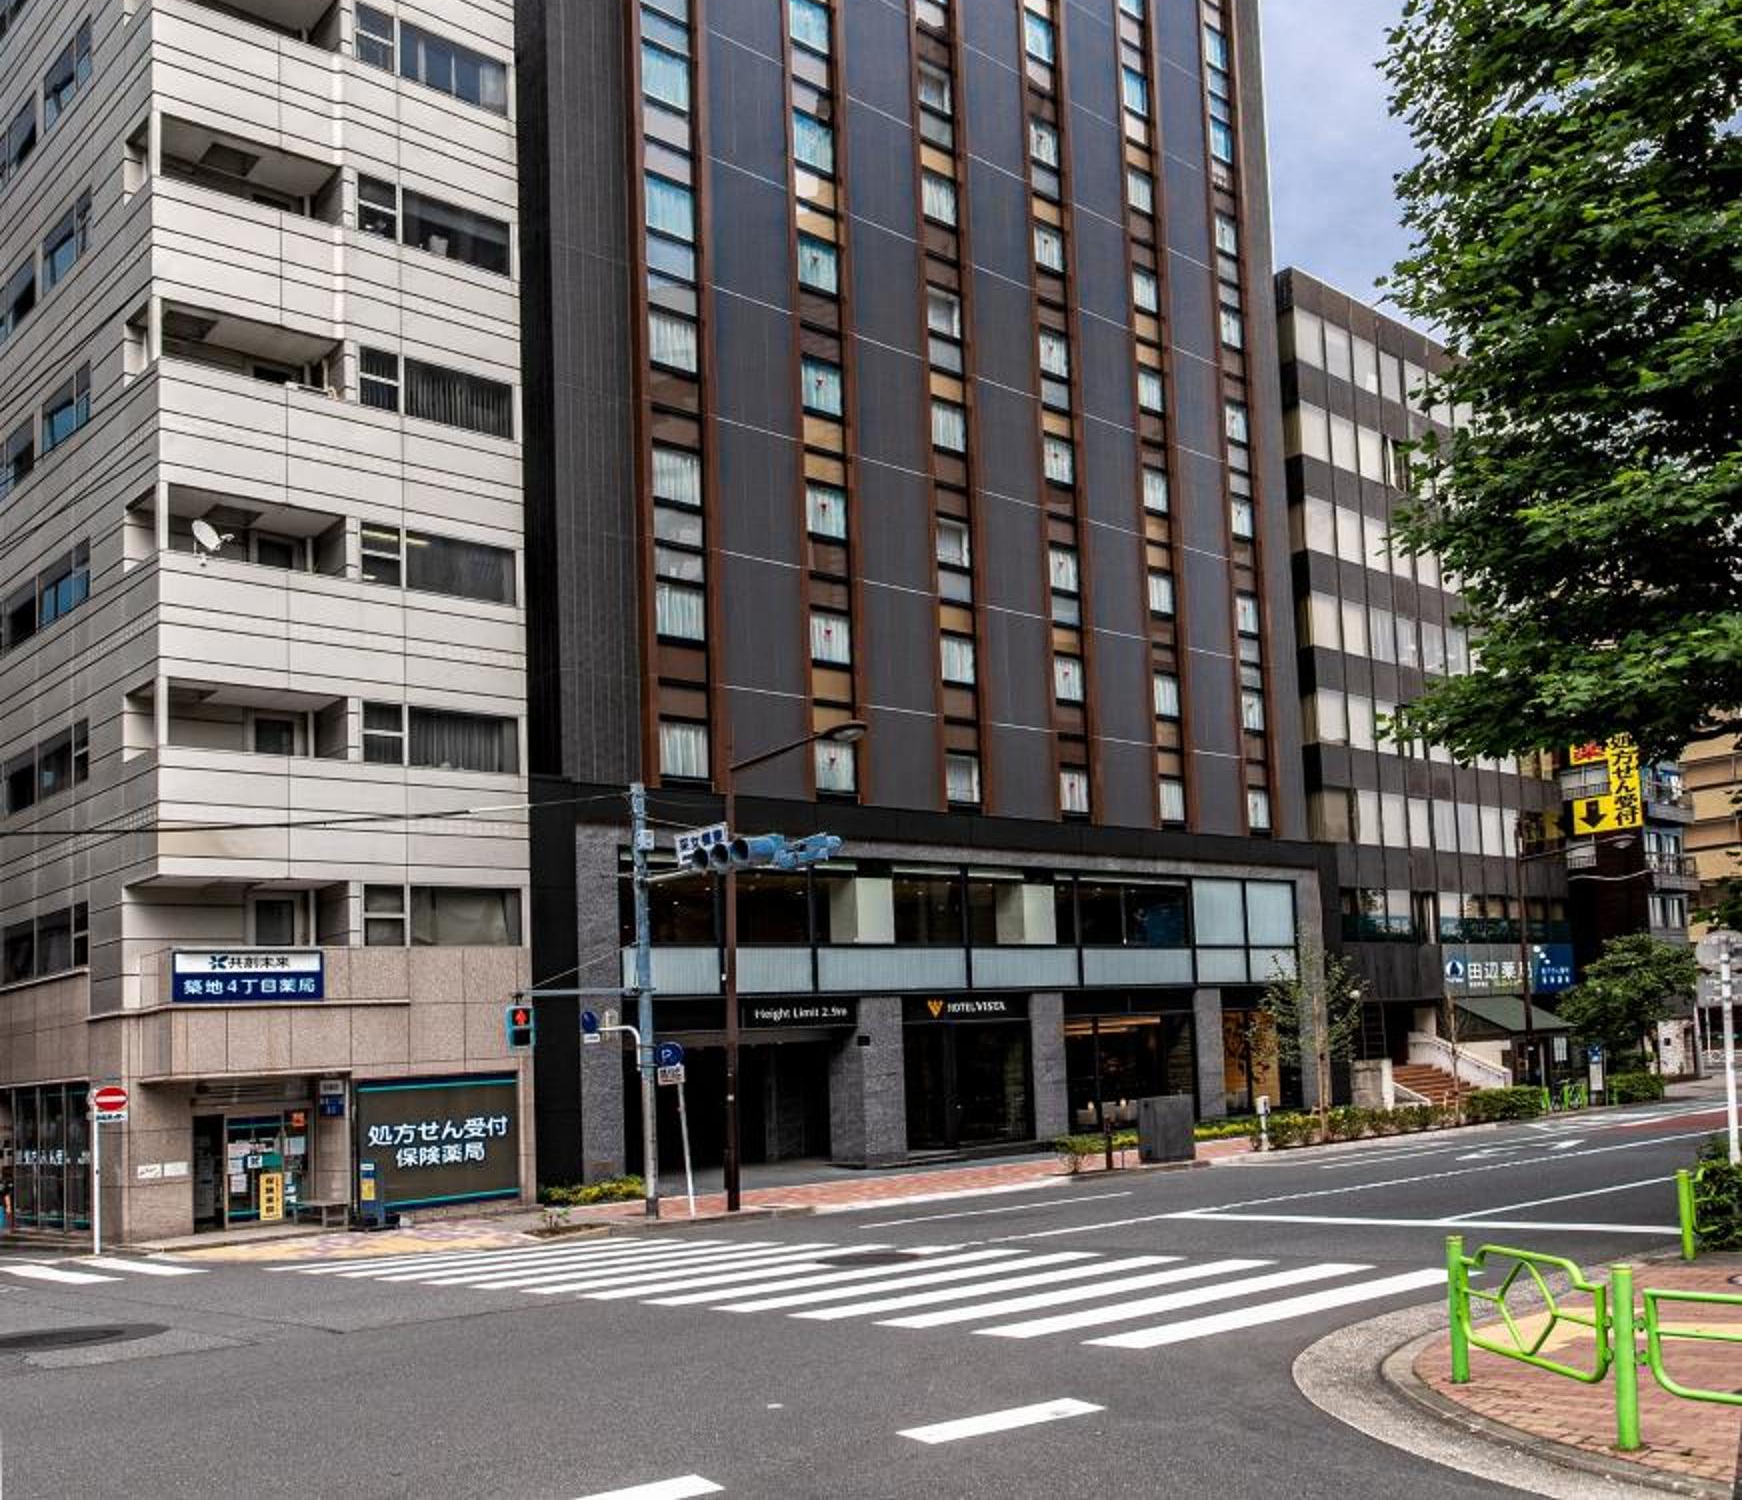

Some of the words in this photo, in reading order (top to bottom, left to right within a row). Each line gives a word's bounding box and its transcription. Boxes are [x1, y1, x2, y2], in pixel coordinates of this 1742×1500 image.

[229, 956, 290, 969] 共創未来
[183, 977, 316, 995] 築地4丁目薬局
[754, 1007, 792, 1022] Height
[793, 1007, 819, 1018] Limit
[975, 1001, 1007, 1012] VISTA
[368, 1115, 508, 1147] 処方せん受付
[395, 1141, 485, 1169] 保険薬局
